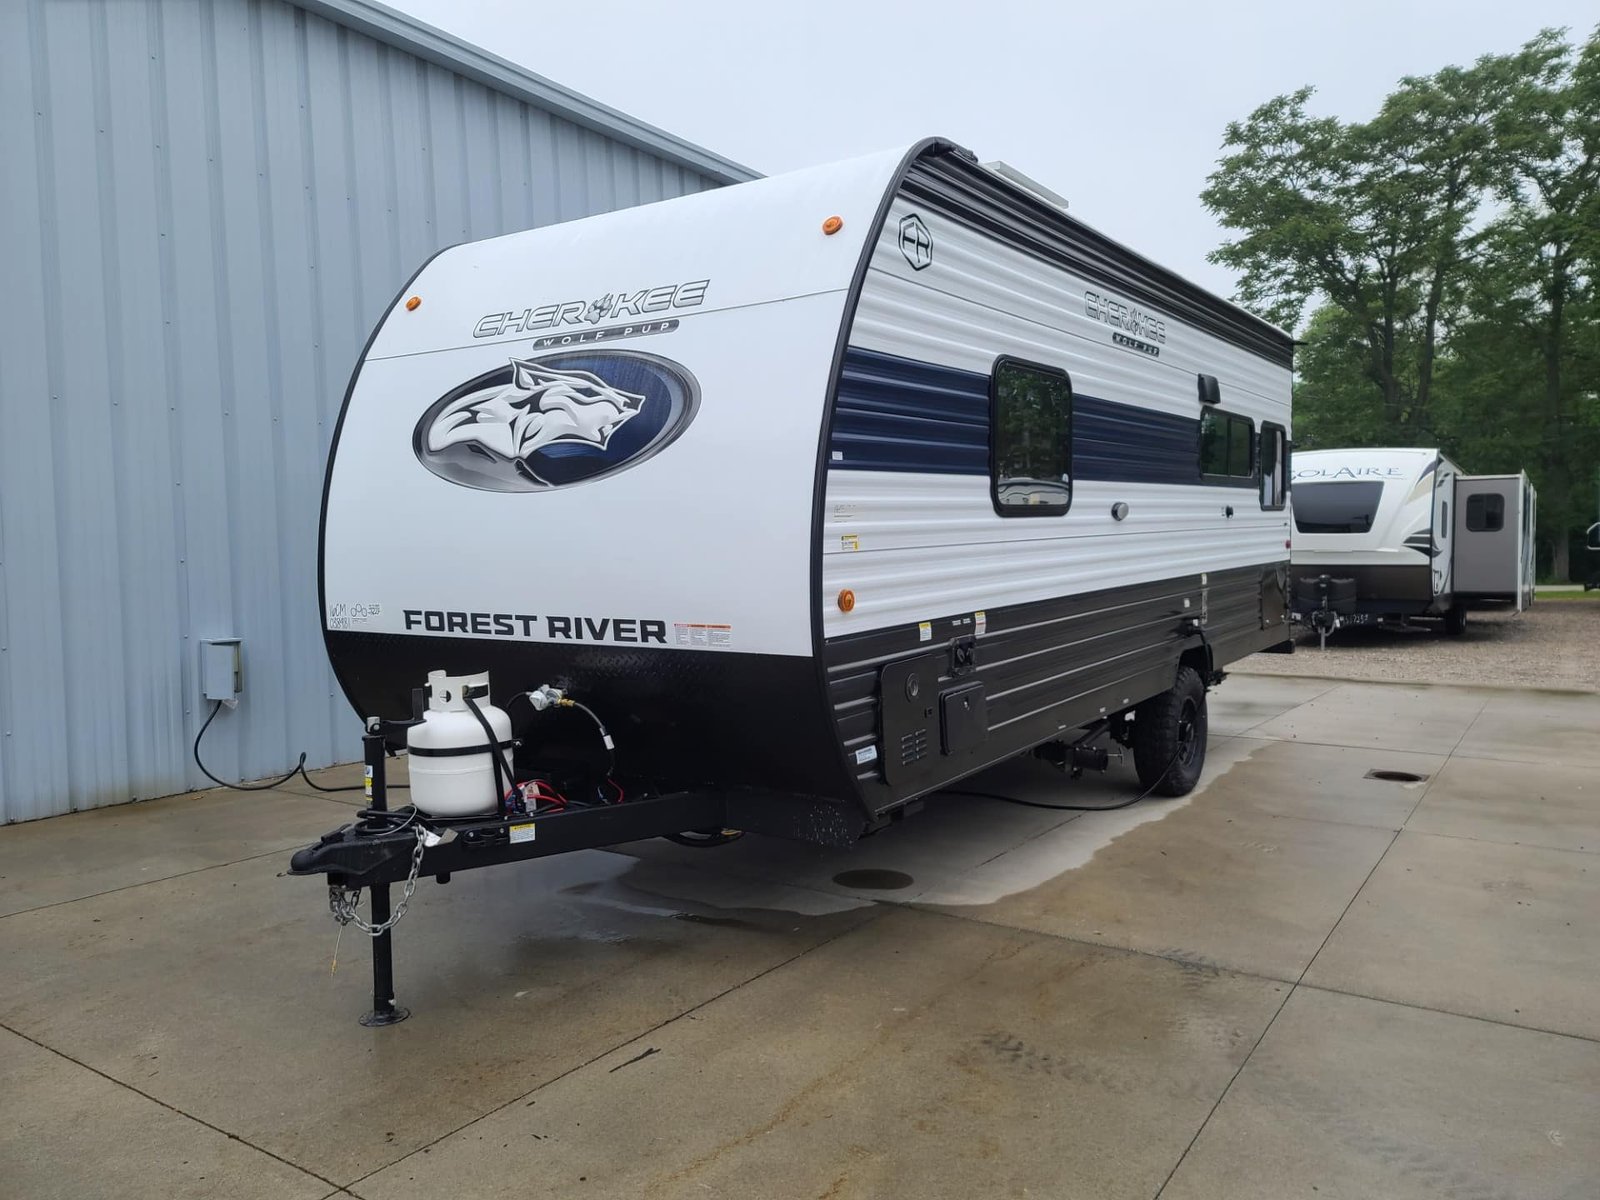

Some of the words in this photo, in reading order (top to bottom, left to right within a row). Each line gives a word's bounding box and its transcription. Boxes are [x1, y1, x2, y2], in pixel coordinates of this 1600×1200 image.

[473, 279, 710, 338] CHEROKEE
[1085, 290, 1166, 344] CHEROKEE
[543, 331, 605, 347] WOLF
[624, 322, 669, 336] PUP
[1115, 334, 1139, 347] WOLF
[403, 609, 538, 637] FOREST
[546, 615, 667, 644] RIVER
